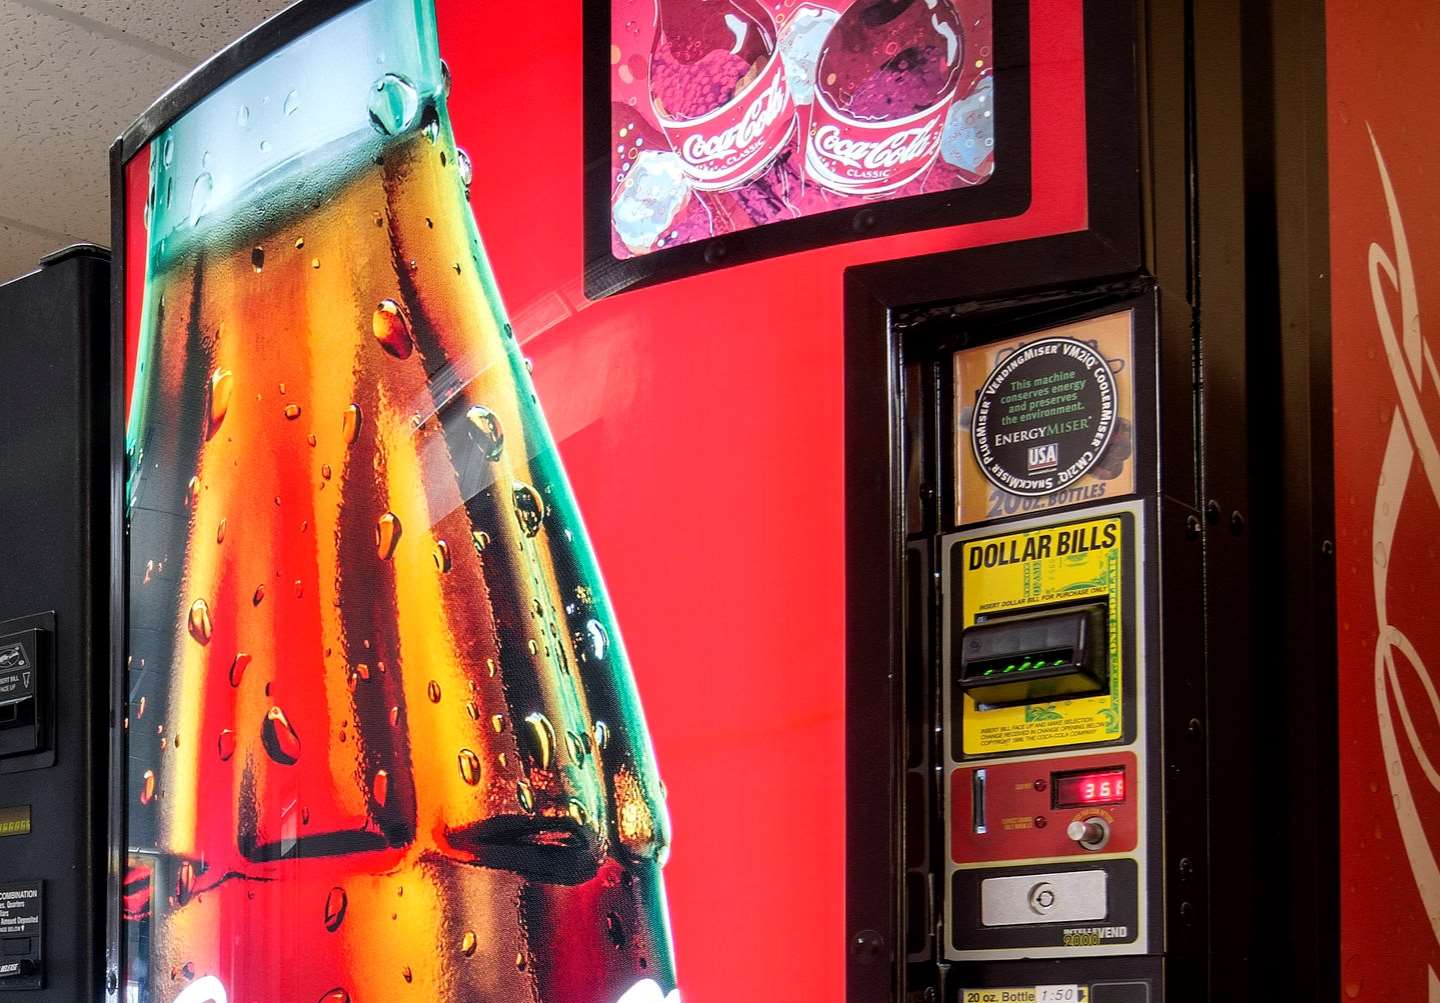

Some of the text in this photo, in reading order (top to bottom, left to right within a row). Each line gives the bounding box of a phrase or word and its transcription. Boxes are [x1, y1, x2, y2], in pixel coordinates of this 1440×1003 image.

[726, 137, 765, 166] CLASSIC
[846, 168, 891, 179] CLASSIC
[1000, 380, 1087, 404] conserves energy
[1010, 370, 1076, 392] This machine
[1001, 403, 1085, 426] the environment.
[1009, 393, 1078, 414] and preserves
[1028, 445, 1057, 465] USA
[987, 483, 1106, 517] 20 BOTTLES
[969, 523, 1117, 570] DOLLAR BILLS
[1000, 598, 1027, 608] DOLLAR
[1041, 593, 1055, 601] FOR
[1055, 588, 1090, 599] PURCHASE
[1090, 586, 1108, 594] ONLY
[966, 993, 981, 1003] 20
[1002, 991, 1035, 1003] Bottle
